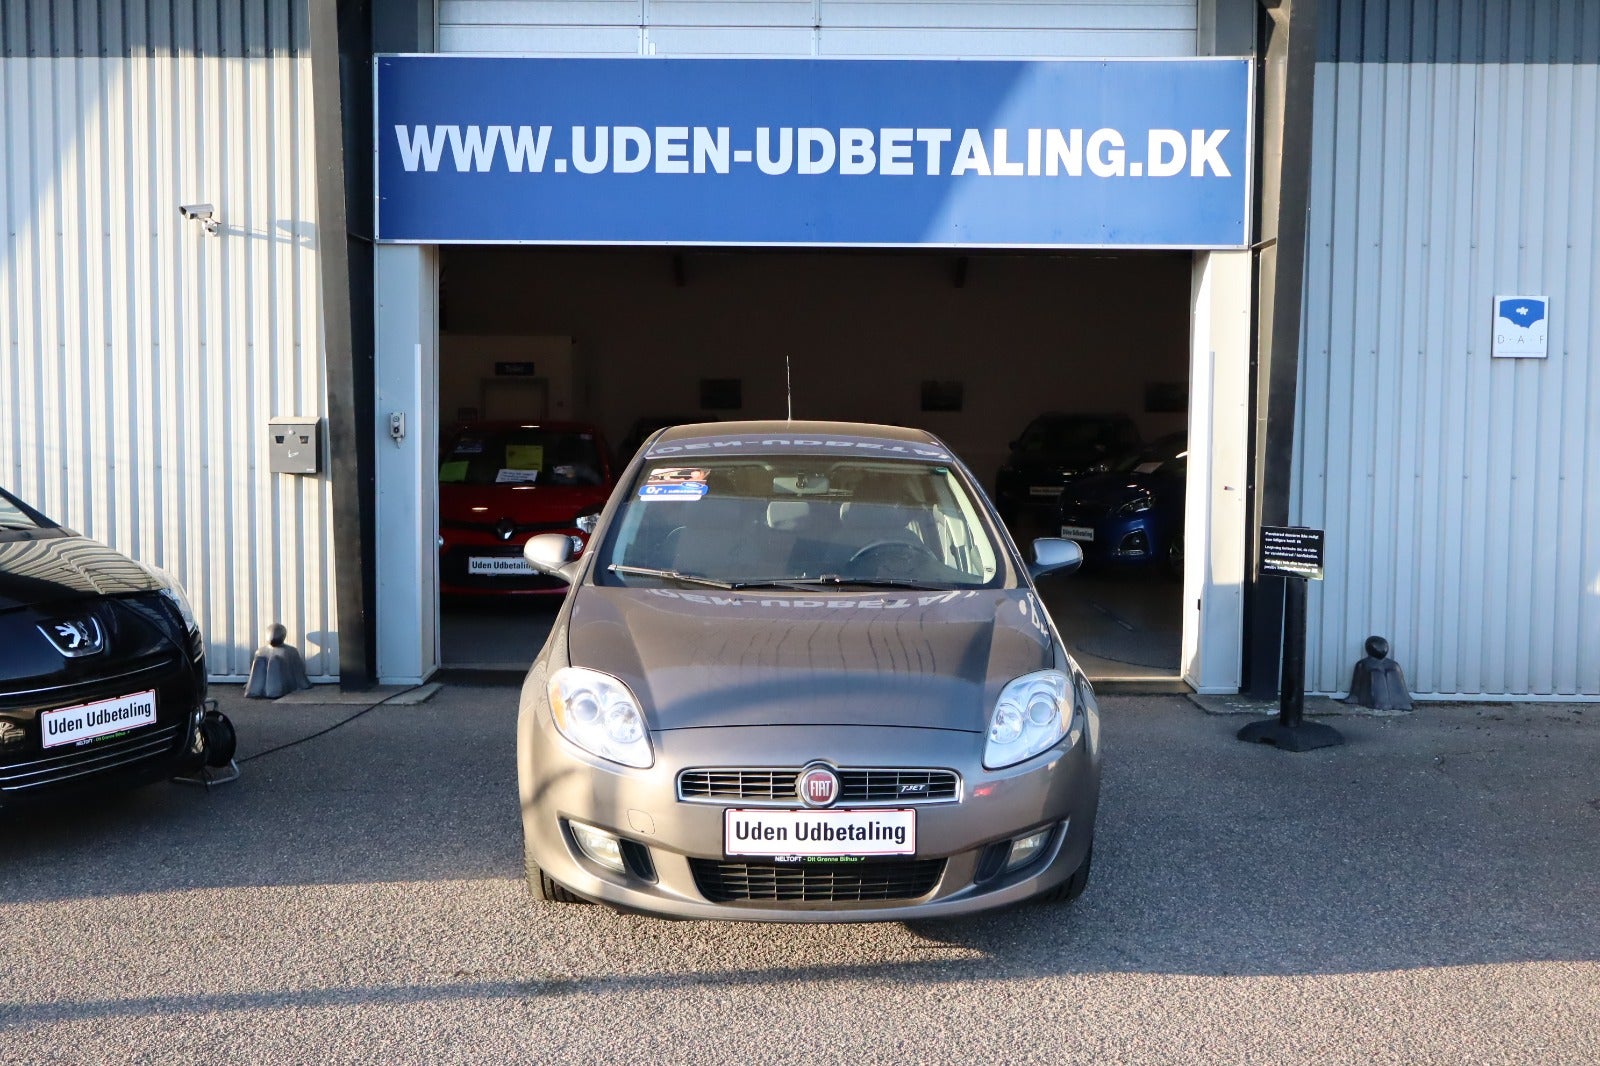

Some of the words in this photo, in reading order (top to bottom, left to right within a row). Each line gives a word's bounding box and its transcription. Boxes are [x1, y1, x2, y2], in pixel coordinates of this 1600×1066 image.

[394, 124, 1232, 179] WWW.UDEN-UDBETALING.DK
[472, 561, 492, 569] Uden
[494, 561, 532, 569] Udbetalin
[49, 718, 83, 735] Uden
[87, 702, 151, 727] Udbetaling
[810, 781, 831, 796] FIAT
[736, 821, 788, 841] Uden
[795, 822, 906, 845] Udbetaling
